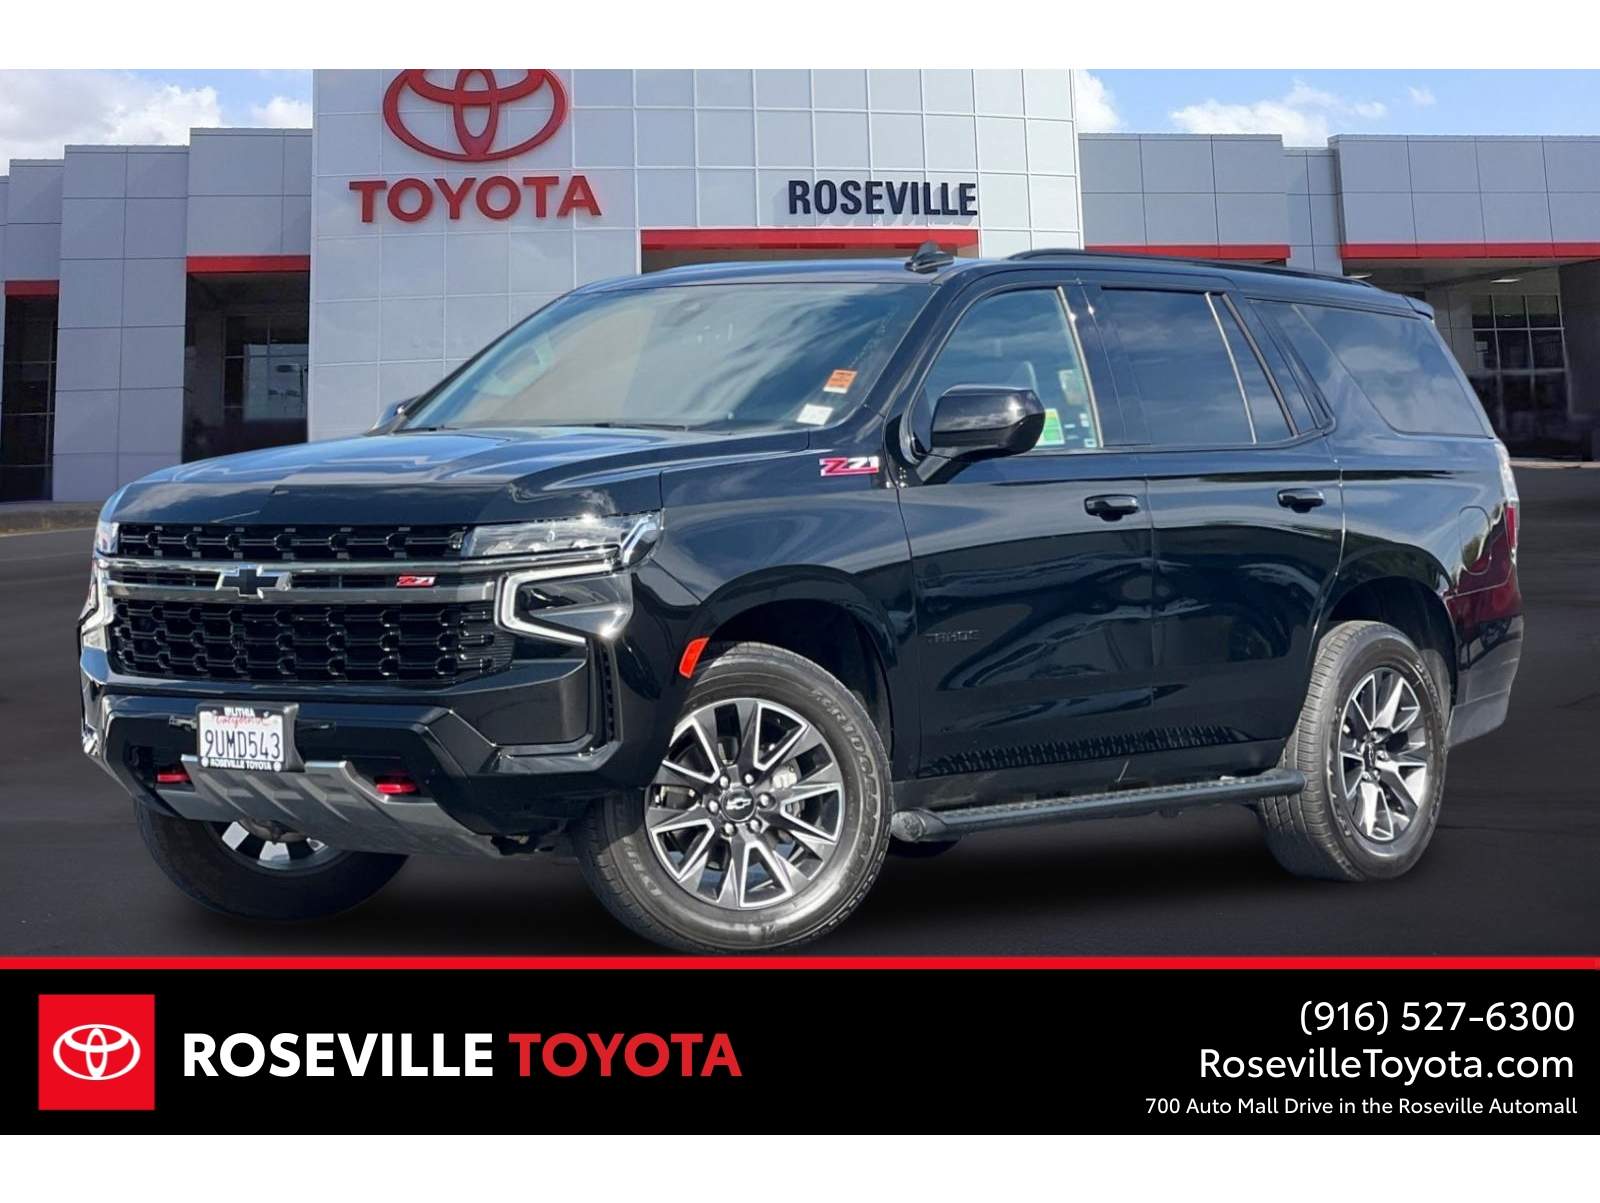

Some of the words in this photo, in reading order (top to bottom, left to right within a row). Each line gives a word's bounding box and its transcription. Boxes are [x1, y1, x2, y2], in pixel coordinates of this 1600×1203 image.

[350, 175, 602, 222] TOYOTA
[788, 179, 978, 216] ROSEVILLE
[819, 456, 879, 476] Z71
[204, 728, 281, 760] 9UMD543
[246, 761, 272, 770] TOYOTA
